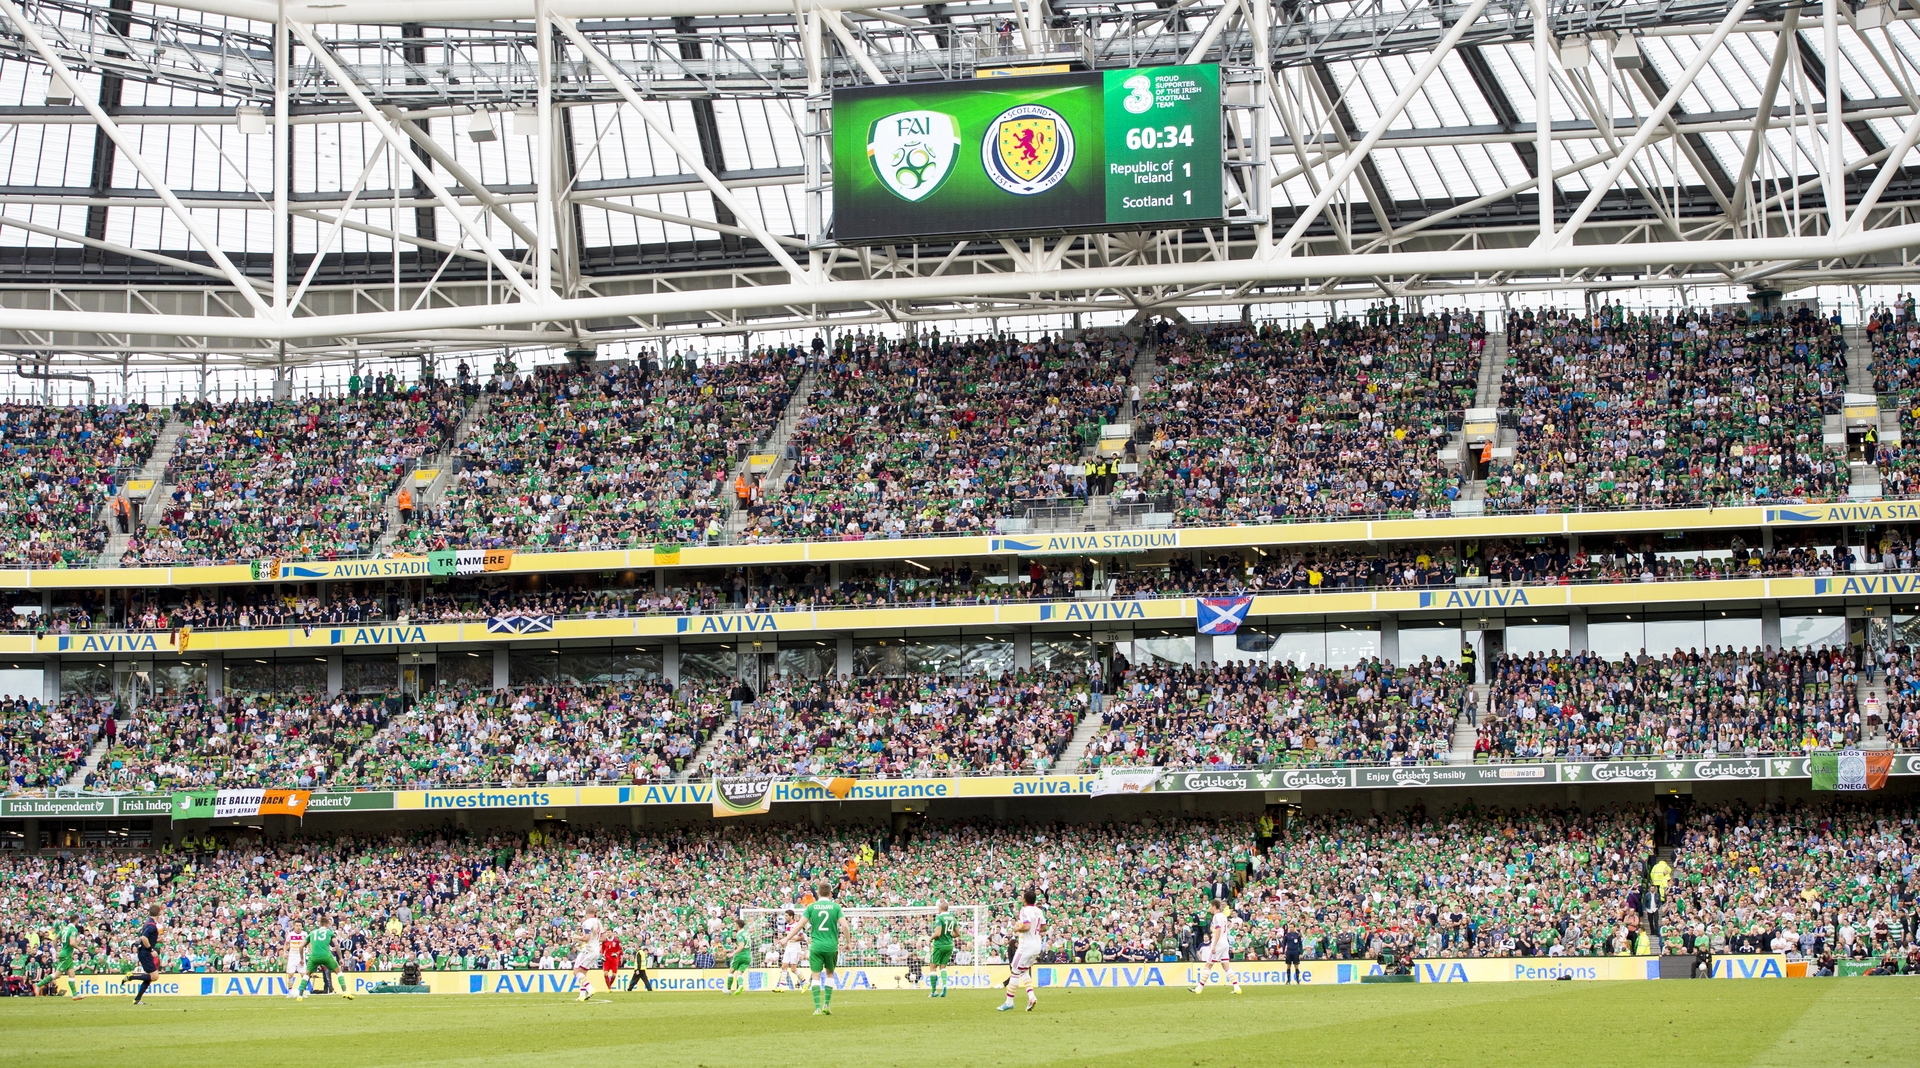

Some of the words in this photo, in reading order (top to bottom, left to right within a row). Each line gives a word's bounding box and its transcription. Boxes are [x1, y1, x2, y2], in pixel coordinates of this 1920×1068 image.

[1156, 94, 1190, 102] FOOTBALL
[1007, 107, 1048, 118] SCOTLAND
[896, 117, 930, 137] FAI
[1126, 125, 1194, 150] 60:34
[1110, 161, 1160, 175] Republic
[1161, 160, 1174, 171] of
[1182, 163, 1191, 177] 1
[995, 174, 1008, 187] EST
[1047, 171, 1063, 185] 1873
[1134, 171, 1173, 184] Ireland
[1122, 194, 1173, 208] Scotland
[1183, 190, 1192, 204] 1
[1828, 506, 1882, 521] AVIVA
[1887, 504, 1920, 519] STA
[1048, 535, 1098, 550] AVIVA
[1103, 533, 1176, 548] STADIUM
[333, 563, 382, 577] AVIVA
[383, 561, 431, 575] STADI
[438, 555, 505, 567] TRANMERE
[254, 569, 278, 578] BOHS
[1842, 575, 1920, 594] AVIVA
[1446, 589, 1529, 608] AVIVA
[1065, 602, 1145, 620] AVIVA
[701, 615, 778, 633] AVIVA
[82, 635, 157, 651] AVIVA
[354, 627, 427, 644] AVIVA
[1111, 768, 1154, 776] Commitment
[1366, 773, 1390, 782] Enjoy
[1392, 769, 1430, 784] Carlsberg
[1433, 771, 1466, 780] Sensibly
[1478, 770, 1497, 778] Visit
[1592, 763, 1657, 780] Carlsberg
[1695, 761, 1760, 778] Carlsberg
[1013, 776, 1093, 795] aviva.ie
[1185, 774, 1247, 790] Carlsberg
[1283, 771, 1346, 788] Carlsberg
[722, 781, 768, 796] YBIG
[776, 784, 835, 800] Home
[9, 802, 32, 812] Irish
[34, 800, 95, 814] Independent
[123, 800, 144, 811] Irish
[146, 799, 172, 813] Indep
[194, 798, 208, 807] WE
[211, 796, 227, 806] ARE
[229, 796, 285, 805] BALLYBRACK
[424, 791, 550, 808] Investments
[818, 910, 829, 931] 2
[944, 920, 954, 935] 14
[313, 930, 327, 941] 13
[1065, 967, 1165, 987] AVIVA
[1187, 968, 1219, 984] Lie
[1368, 963, 1469, 983] AIVA
[1515, 963, 1597, 979] Pensions
[76, 979, 99, 995] ife
[495, 974, 580, 993] AVIVA
[645, 977, 725, 990] nsurance
